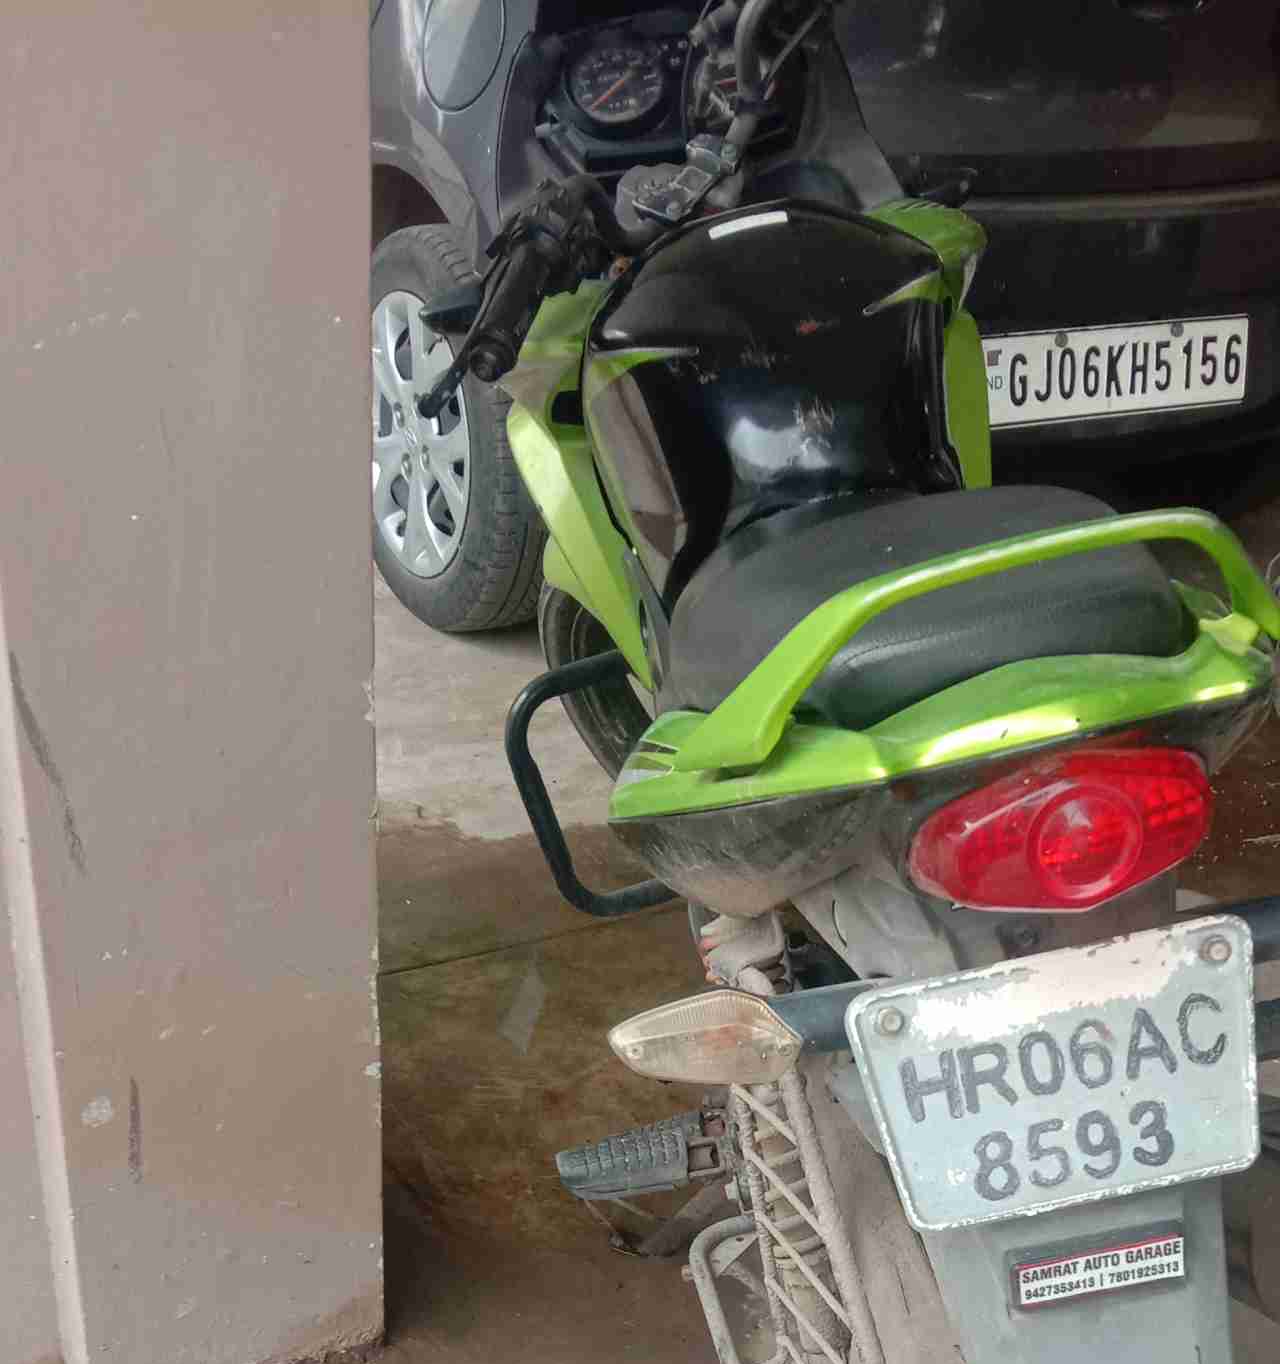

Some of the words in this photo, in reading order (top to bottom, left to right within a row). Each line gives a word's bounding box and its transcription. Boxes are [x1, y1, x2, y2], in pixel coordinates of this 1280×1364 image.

[987, 375, 1003, 391] ND
[1009, 334, 1241, 406] GJ06KH5156
[900, 993, 1228, 1123] HR06AC
[974, 1100, 1175, 1201] 8593
[1022, 1261, 1079, 1284] SAMRAT
[1083, 1253, 1121, 1272] AUTO
[1125, 1241, 1181, 1264] GARAGE
